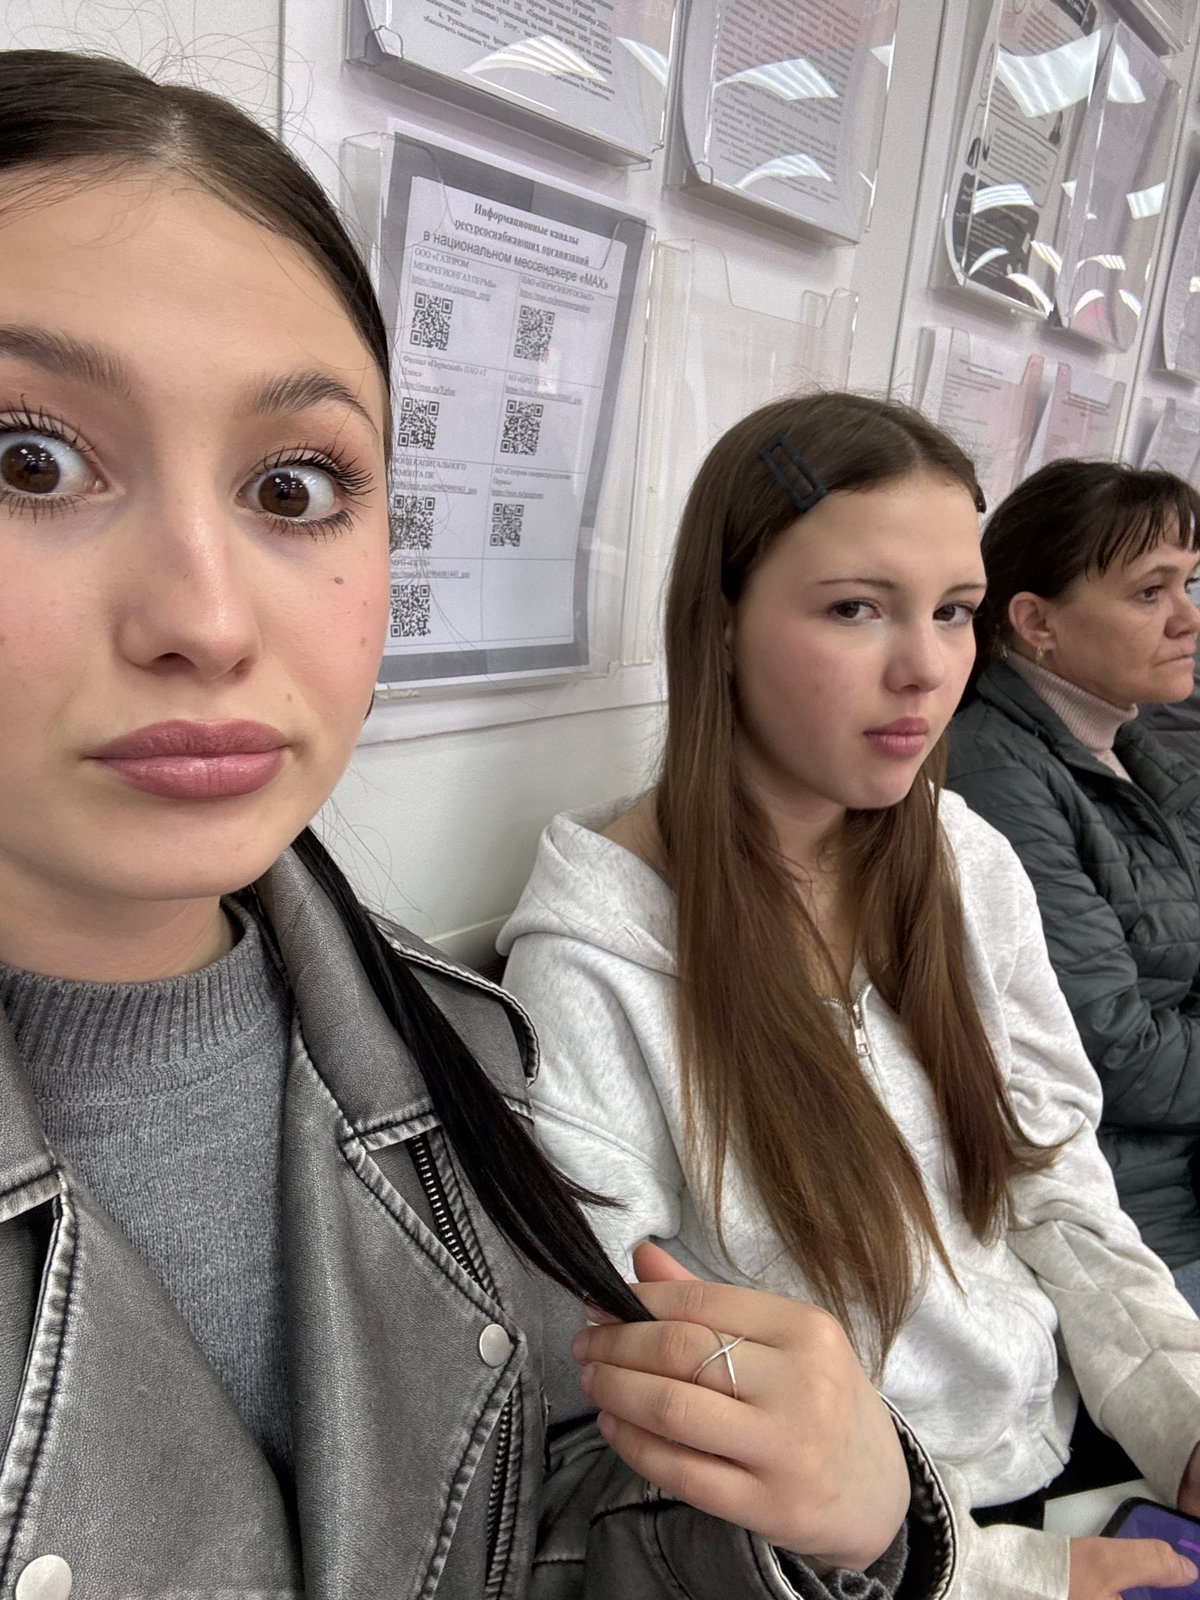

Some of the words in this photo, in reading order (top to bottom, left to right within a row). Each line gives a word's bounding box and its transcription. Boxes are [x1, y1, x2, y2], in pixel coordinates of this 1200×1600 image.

[455, 219, 539, 251] ресурсоснабжающих
[541, 243, 590, 267] организаций
[474, 203, 548, 237] Информационные
[549, 229, 579, 246] каналы
[433, 233, 512, 265] национальном
[513, 254, 578, 282] мессенджере
